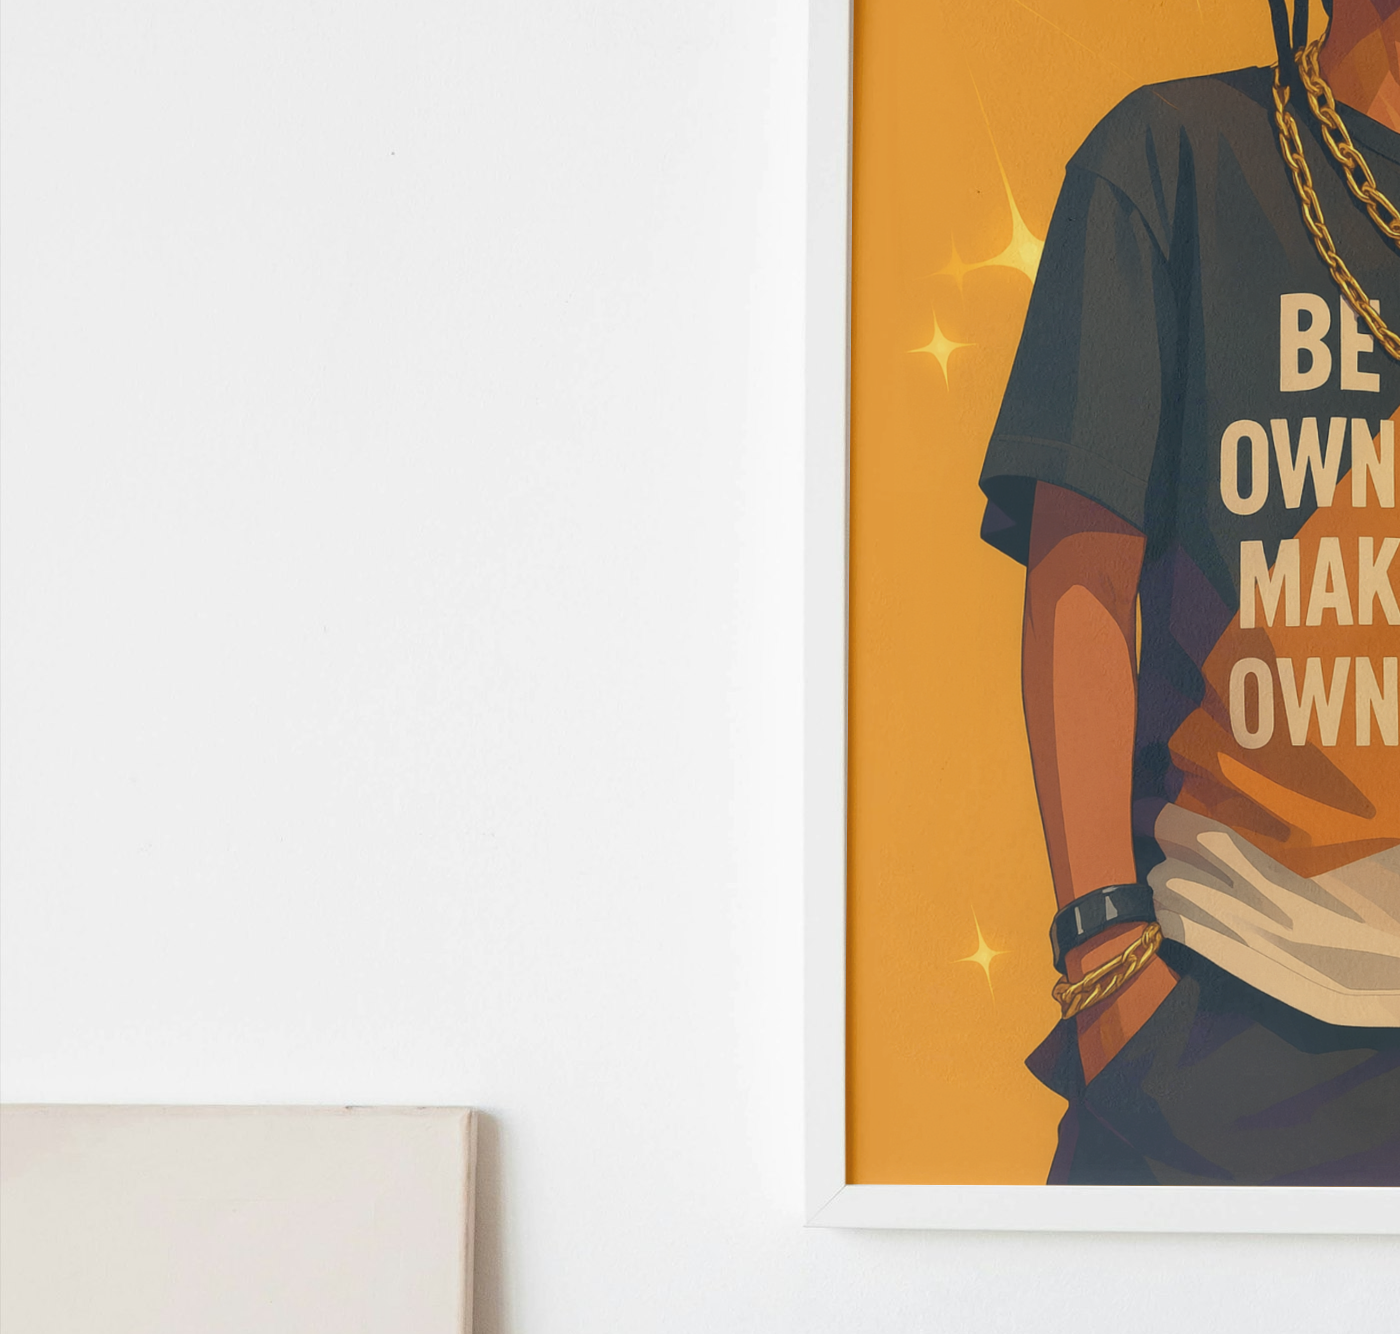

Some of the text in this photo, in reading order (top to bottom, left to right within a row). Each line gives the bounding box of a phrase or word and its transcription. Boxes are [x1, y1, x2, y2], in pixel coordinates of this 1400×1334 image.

[1279, 292, 1381, 393] BE
[1219, 416, 1396, 516] OWN
[1228, 656, 1400, 750] OWN
